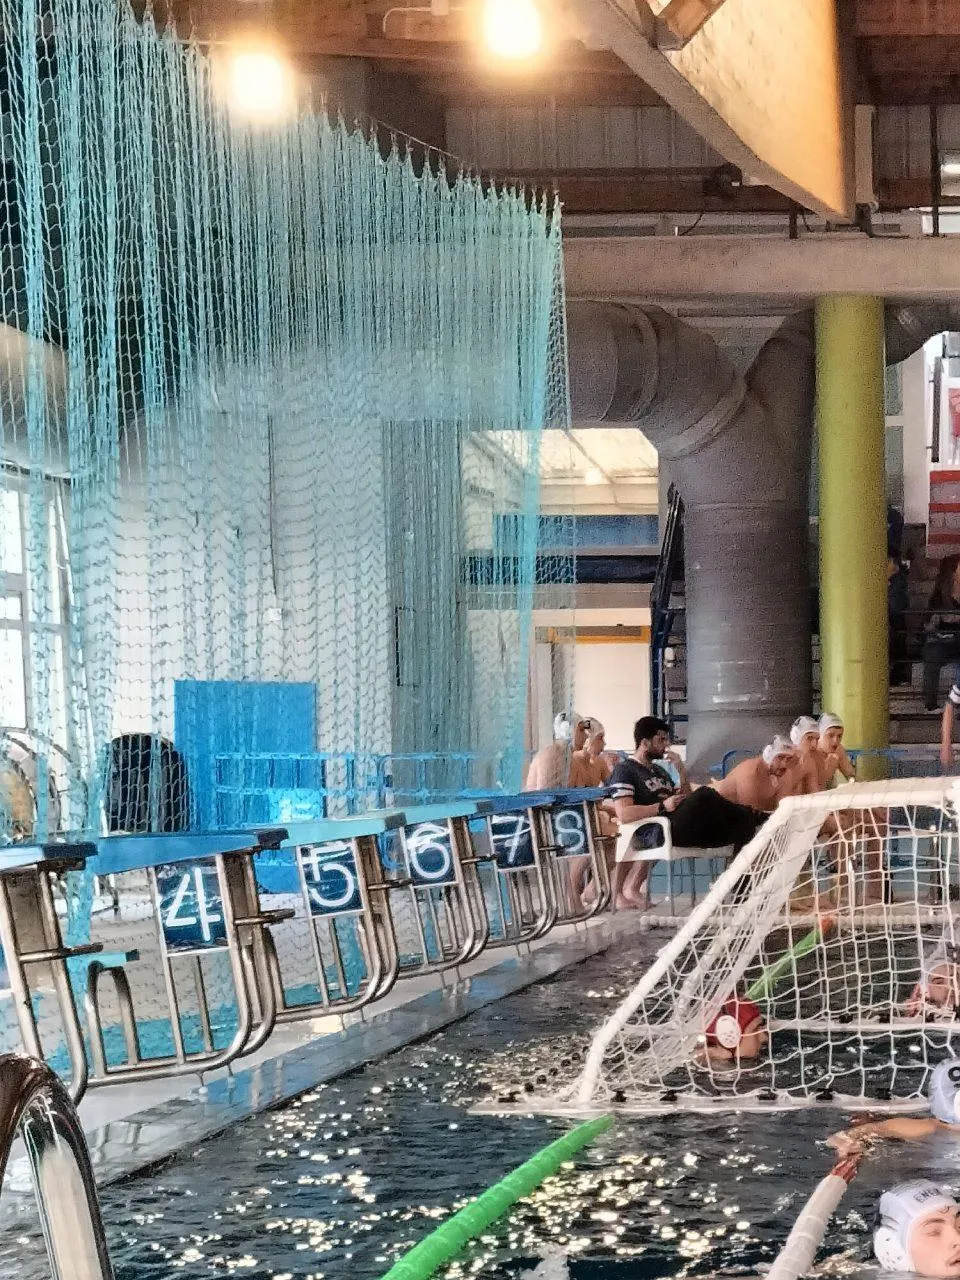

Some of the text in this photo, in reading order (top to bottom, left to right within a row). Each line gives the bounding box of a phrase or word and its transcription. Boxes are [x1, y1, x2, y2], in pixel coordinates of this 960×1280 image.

[406, 823, 452, 879] 6
[492, 815, 532, 863] 7
[553, 811, 583, 851] 8
[302, 843, 356, 906] 5
[166, 867, 221, 942] 4
